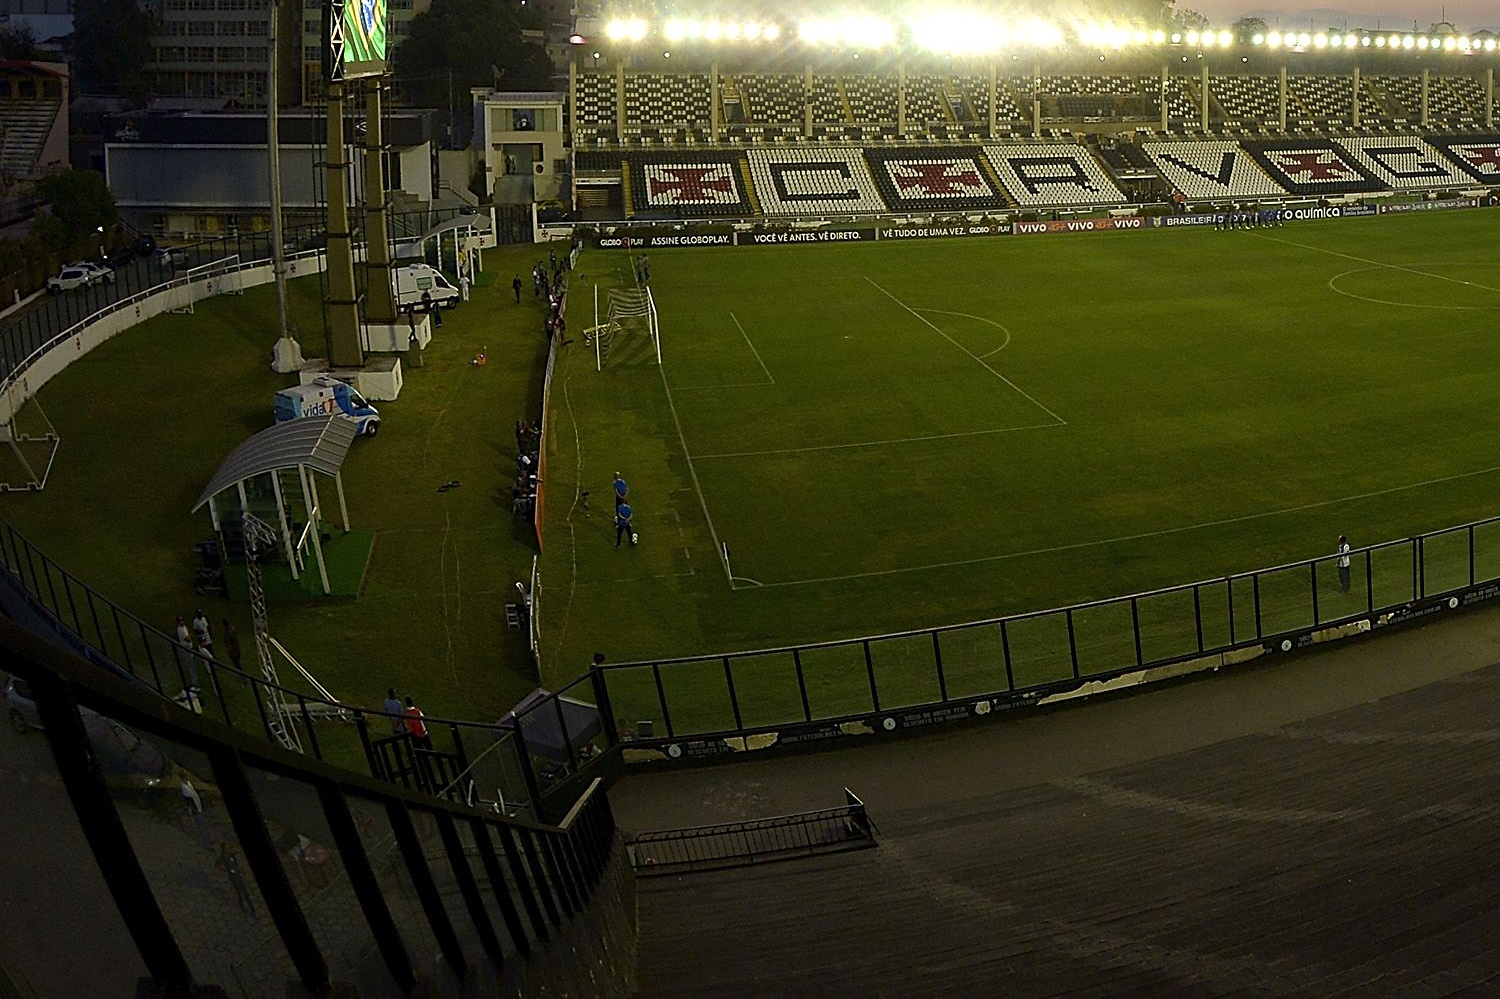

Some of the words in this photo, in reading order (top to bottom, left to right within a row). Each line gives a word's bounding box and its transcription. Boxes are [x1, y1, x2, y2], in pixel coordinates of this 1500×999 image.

[969, 226, 990, 234] GLOBO
[998, 225, 1010, 233] PLAY
[1019, 223, 1047, 233] VIVO
[1067, 221, 1094, 231] VIVO
[1114, 219, 1141, 228] VIVO
[754, 232, 776, 243] VOCÊ
[776, 231, 788, 243] VÊ
[789, 233, 817, 242] ANTES.
[818, 230, 829, 241] VÊ
[830, 231, 861, 240] DIRETO.
[883, 228, 894, 238] VÊ
[894, 229, 917, 237] TUDO
[918, 228, 928, 237] DE
[930, 228, 948, 236] UMA
[949, 227, 966, 235] VEZ.
[600, 238, 621, 247] GLOBO
[630, 238, 644, 246] PLAY
[651, 236, 680, 245] ASSINE
[680, 234, 730, 245] GLOBOPLAY.
